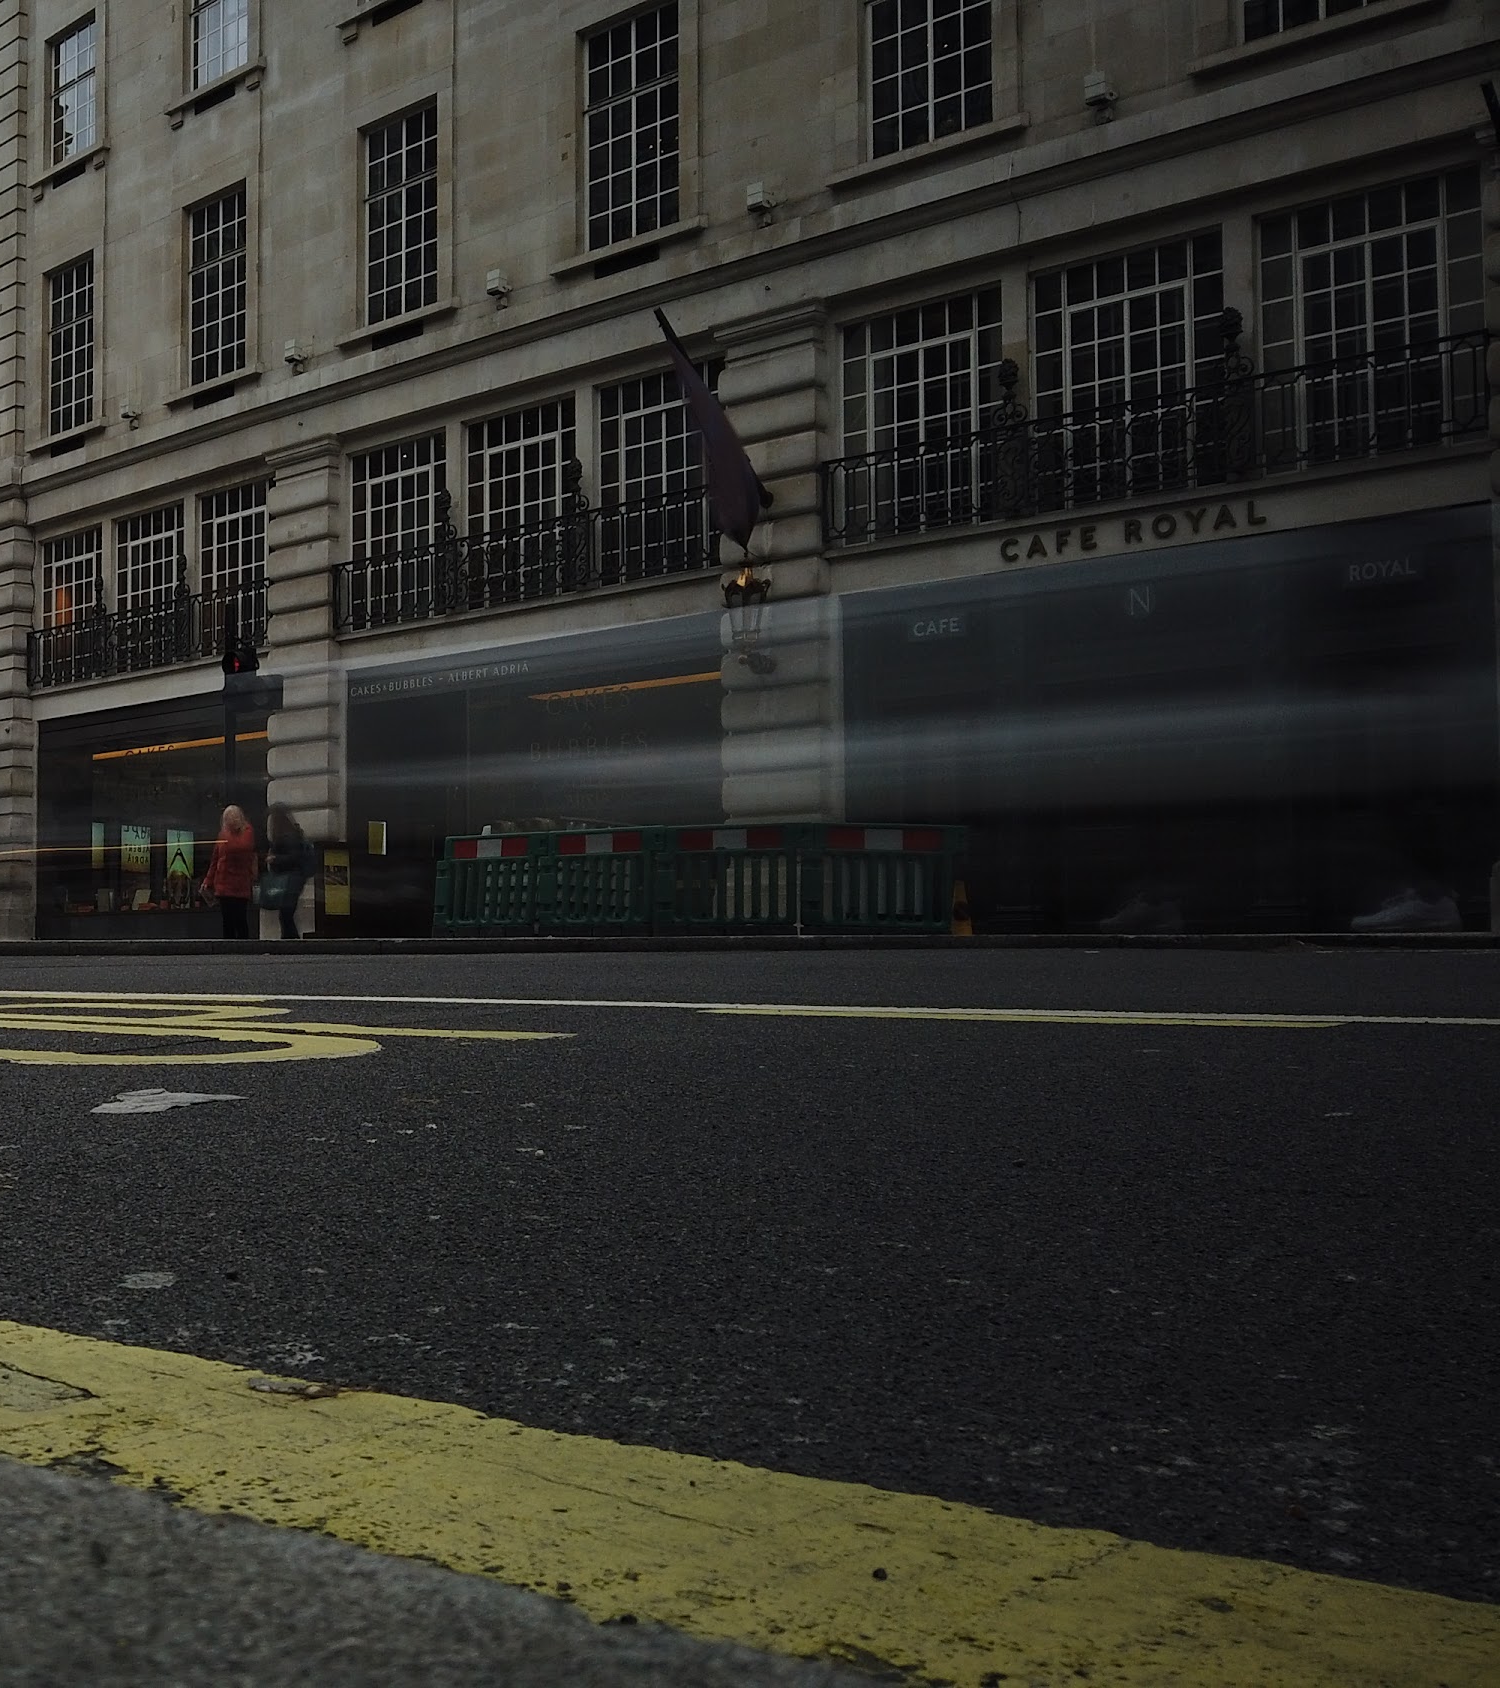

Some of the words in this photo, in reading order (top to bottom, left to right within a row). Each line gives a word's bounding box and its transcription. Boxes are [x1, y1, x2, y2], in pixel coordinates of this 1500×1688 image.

[1000, 525, 1098, 563] CAFE
[1123, 500, 1267, 544] ROYAL
[1348, 556, 1418, 582] ROYAL
[913, 616, 960, 637] CAFE
[447, 667, 489, 683] ALBERT
